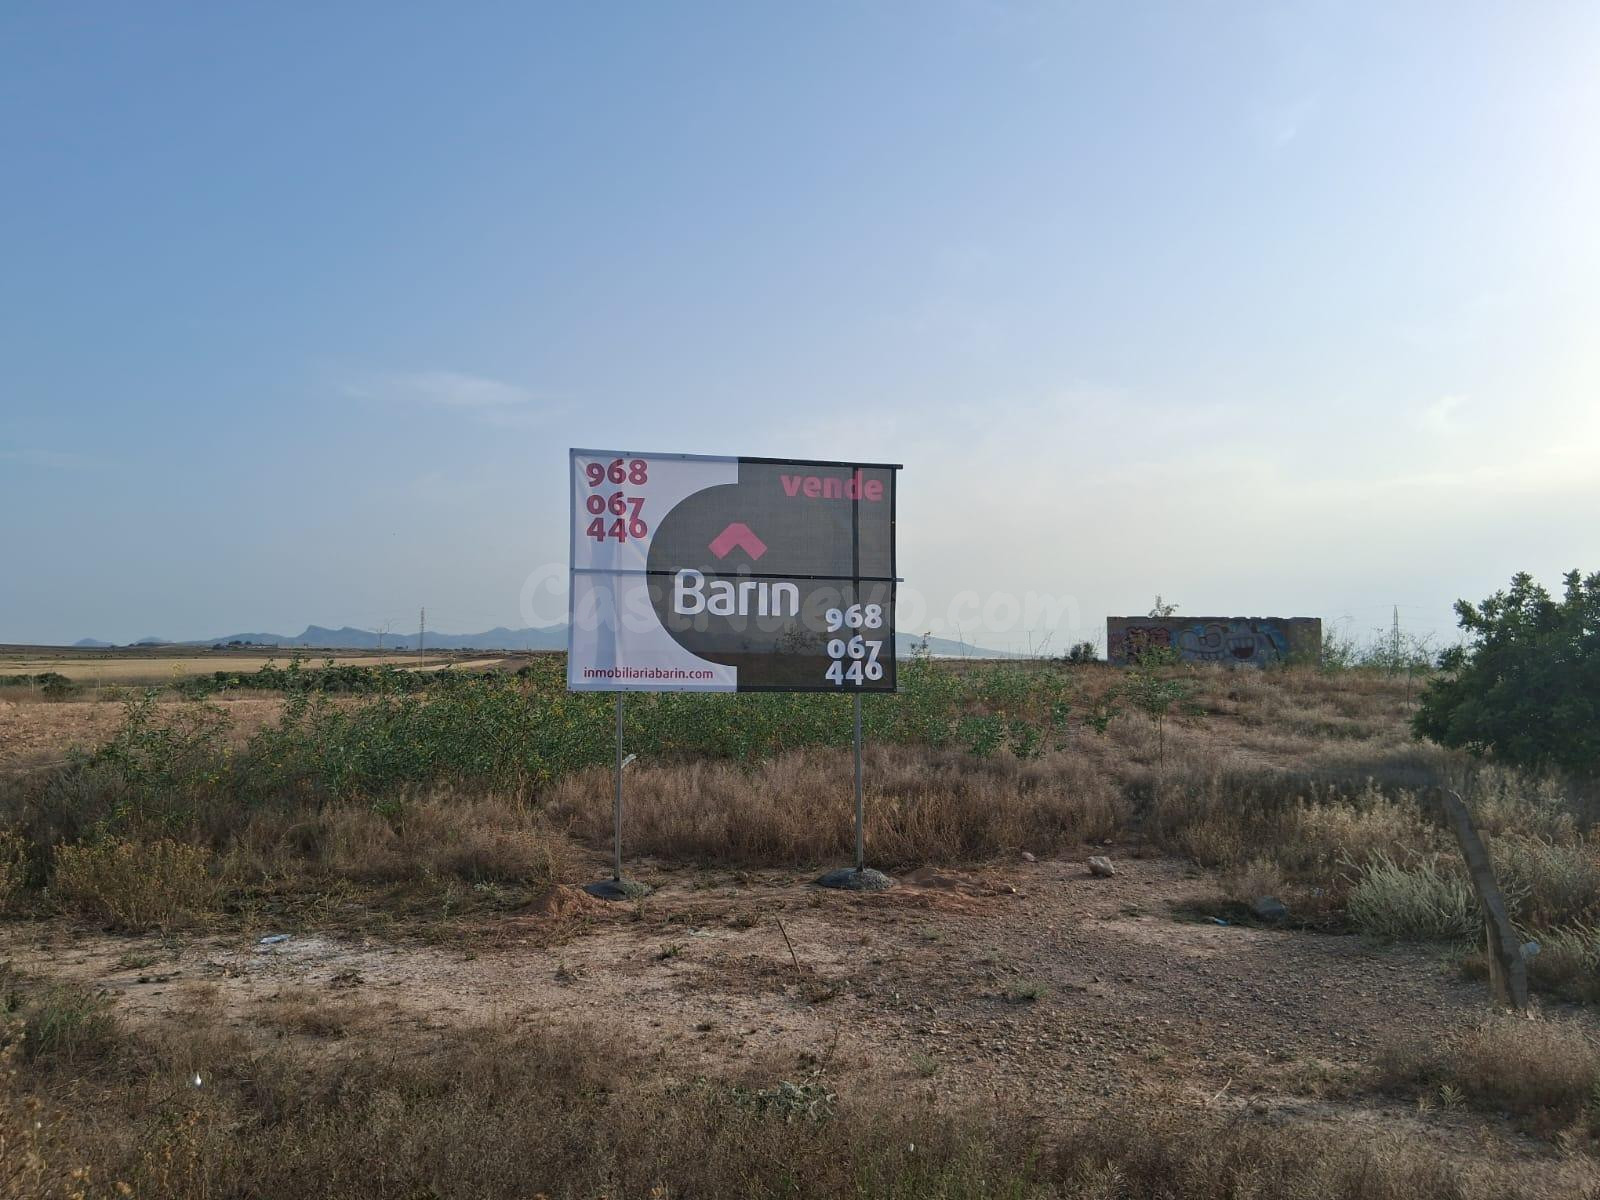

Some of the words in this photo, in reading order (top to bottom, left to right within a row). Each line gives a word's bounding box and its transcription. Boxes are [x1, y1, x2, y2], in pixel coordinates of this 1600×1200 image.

[586, 458, 648, 487] 968
[780, 470, 884, 500] vende
[586, 491, 645, 521] 067
[586, 517, 648, 543] 446
[673, 568, 800, 617] Barin
[824, 603, 882, 633] 968
[826, 635, 883, 664] 067
[583, 666, 714, 680] inmobiliariabarin.com
[825, 659, 883, 685] 446
